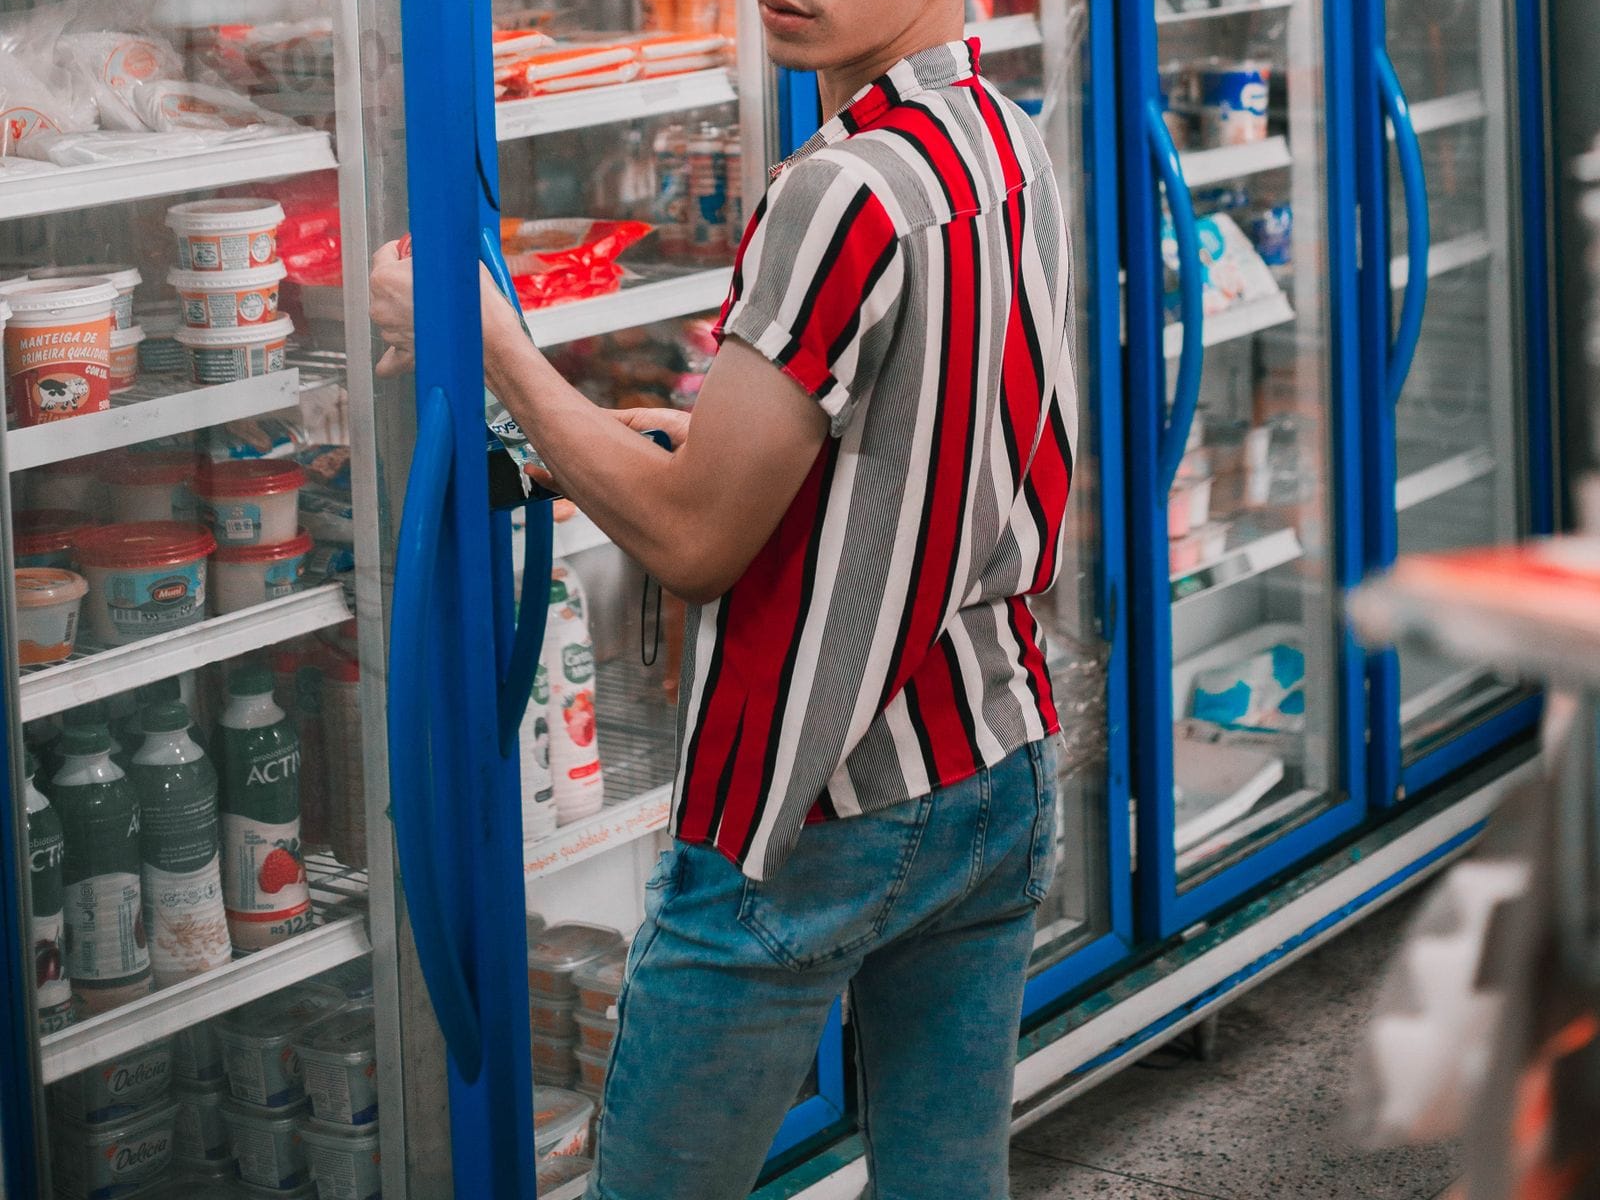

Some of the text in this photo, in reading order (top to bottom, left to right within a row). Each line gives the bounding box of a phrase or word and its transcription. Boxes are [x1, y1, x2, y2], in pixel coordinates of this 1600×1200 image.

[20, 331, 98, 351] MANTEIGA DE
[21, 349, 65, 366] PRIMEIRA
